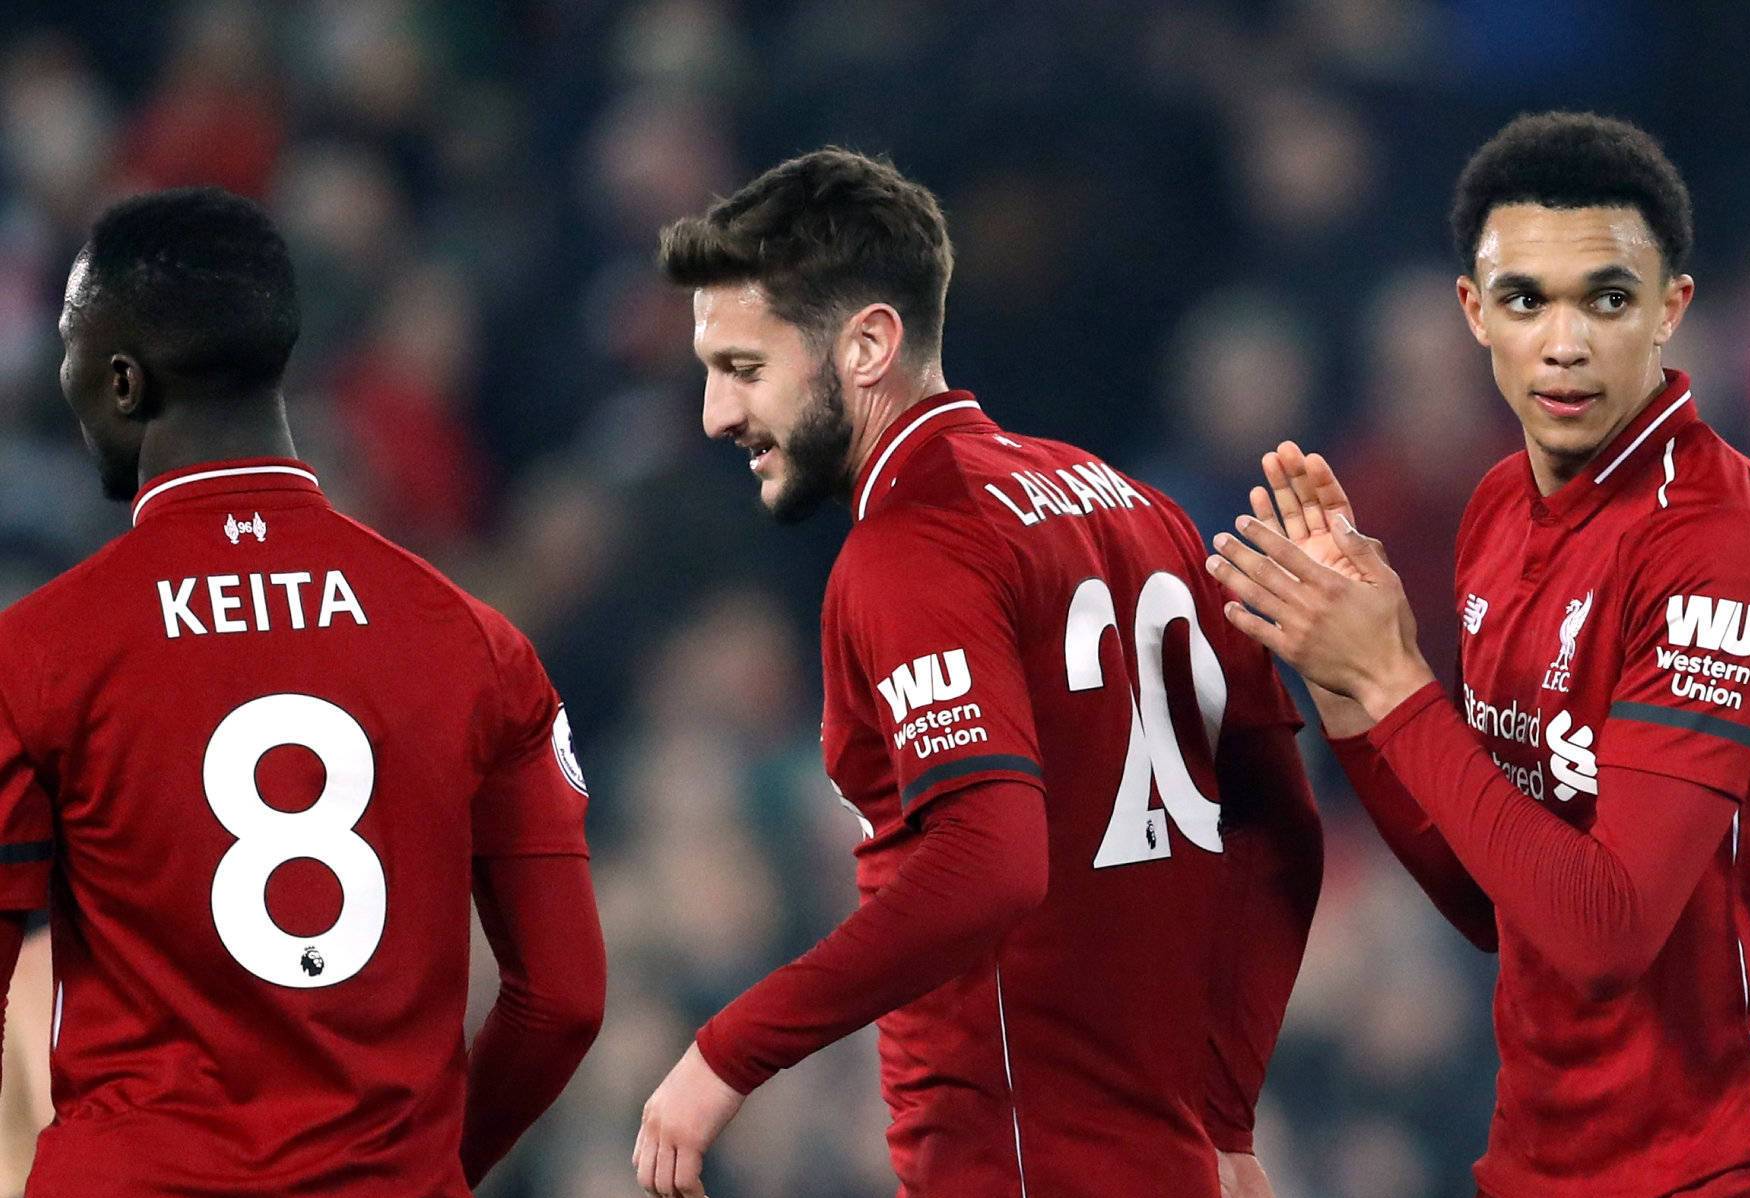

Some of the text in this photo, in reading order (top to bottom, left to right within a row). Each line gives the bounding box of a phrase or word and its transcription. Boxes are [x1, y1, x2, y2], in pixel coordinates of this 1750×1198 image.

[156, 569, 369, 639] KEITA
[876, 648, 973, 725] WU
[1064, 571, 1228, 869] 20
[1670, 672, 1743, 711] Union
[892, 702, 982, 751] Western
[913, 726, 988, 759] Union
[202, 693, 387, 989] 8
